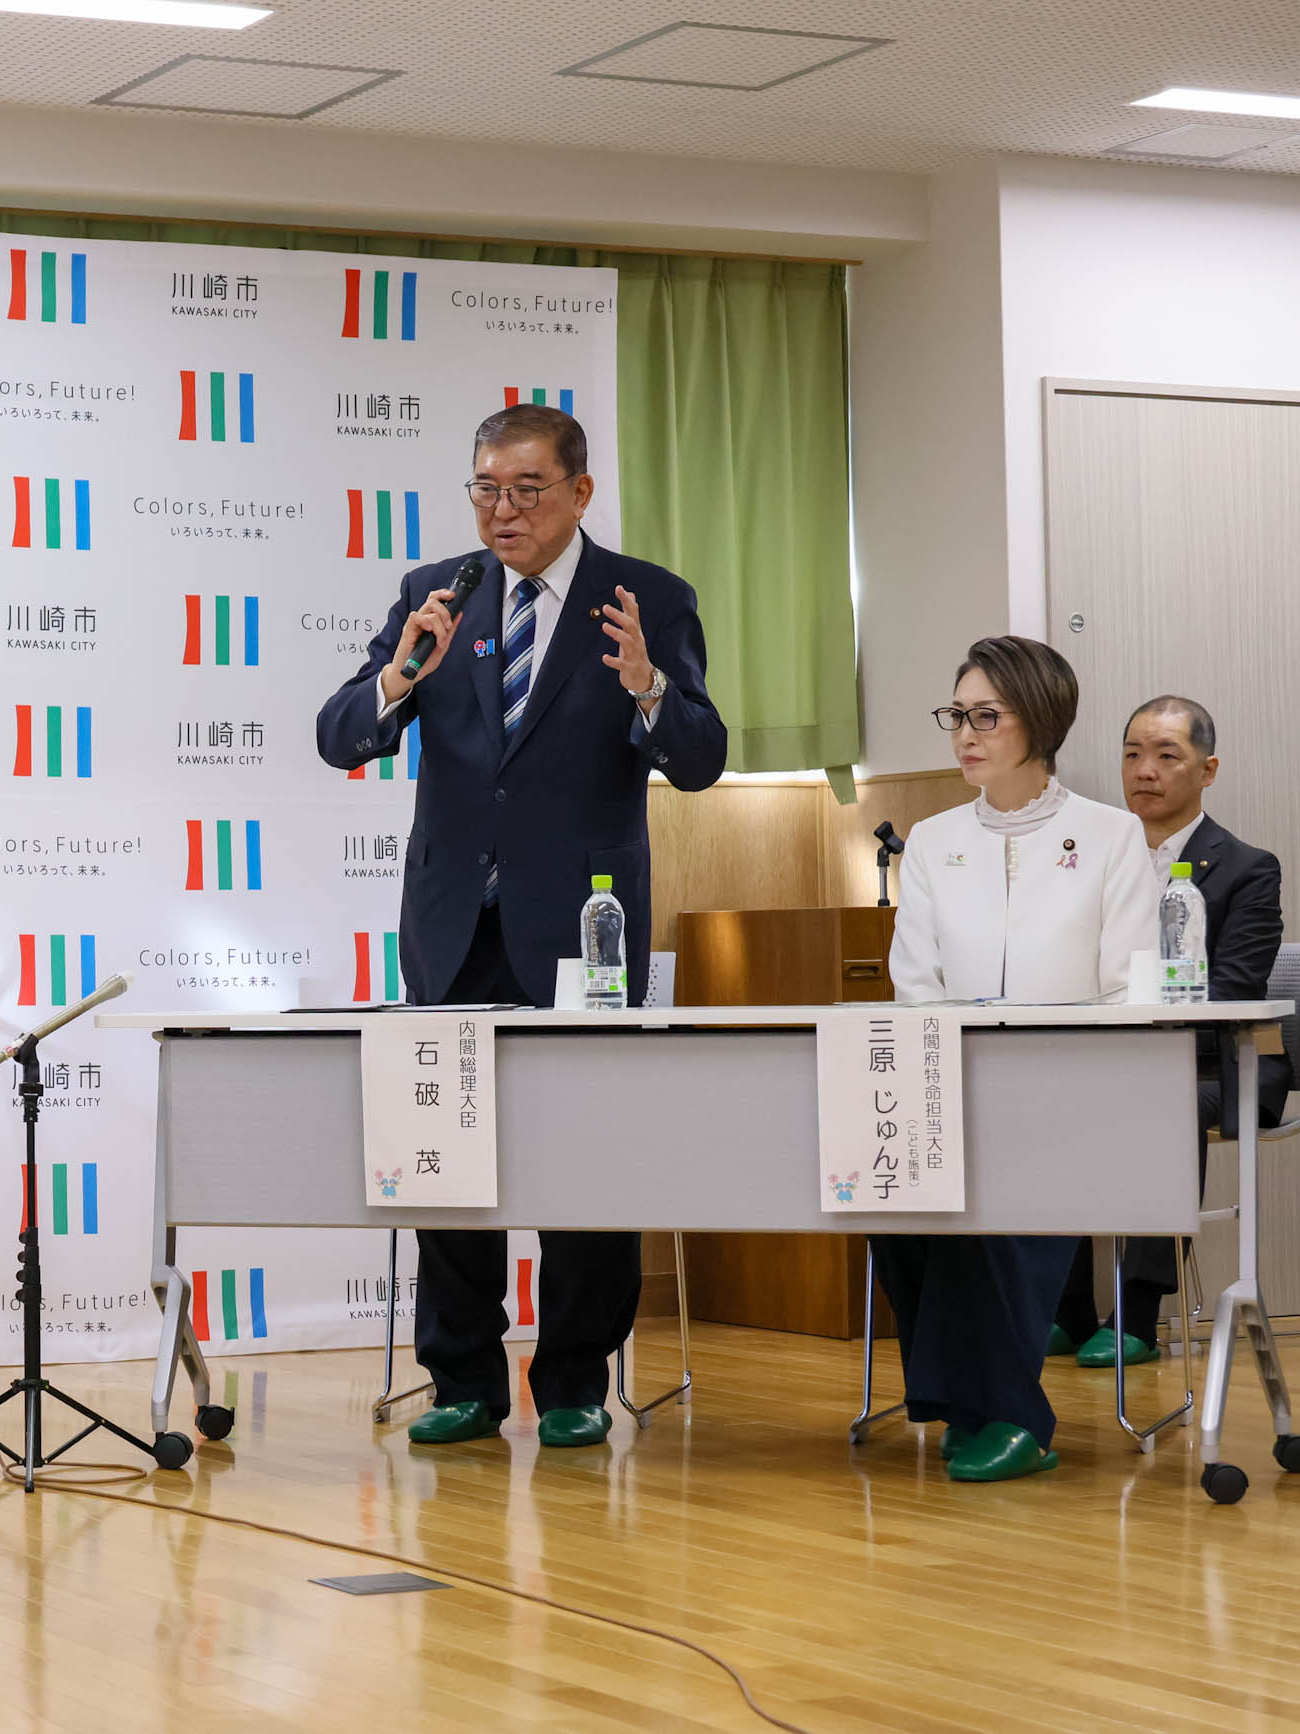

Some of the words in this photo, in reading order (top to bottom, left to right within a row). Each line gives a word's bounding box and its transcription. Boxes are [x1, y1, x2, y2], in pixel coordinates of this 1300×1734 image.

[171, 272, 259, 303] 川崎市
[171, 305, 228, 318] KAWASAKI
[232, 308, 258, 319] CITY
[451, 290, 528, 313] Colors,
[534, 295, 613, 314] Future!
[485, 320, 580, 335] いろいろって、未来。
[50, 380, 135, 401] Future!
[336, 392, 421, 422] 川崎市
[336, 425, 392, 438] KAWASAKI
[396, 427, 421, 439] CITY
[133, 496, 214, 518] Colors,
[221, 499, 304, 520] Future!
[170, 526, 270, 540] いろいろって、未来。
[6, 604, 97, 634] 川崎市
[7, 638, 66, 651] KAWASAKI
[70, 640, 97, 652] CITY
[176, 720, 265, 749] 川崎市
[176, 754, 234, 766] KAWASAKI
[238, 755, 264, 766] CITY
[56, 836, 141, 854] Future!
[344, 834, 410, 861] 川崎
[3, 863, 106, 877] いろいろって、未来。
[344, 868, 399, 878] KAWASAKI
[139, 948, 220, 968] Colors,
[227, 947, 310, 966] Future!
[176, 975, 276, 989] いろいろって、未来。
[868, 1020, 896, 1073] 三原
[415, 1041, 440, 1106] 石破
[459, 1020, 477, 1128] 内閣総理大臣
[12, 1097, 70, 1108] KAASAKI
[75, 1097, 101, 1107] CITY
[923, 1016, 944, 1169] 内閣府特命担当大臣
[872, 1090, 900, 1200] じゅん子
[415, 1149, 441, 1175] 茂
[62, 1290, 147, 1311] Future!
[349, 1308, 406, 1320] KAWASKI
[8, 1322, 113, 1334] いろって、未来。
